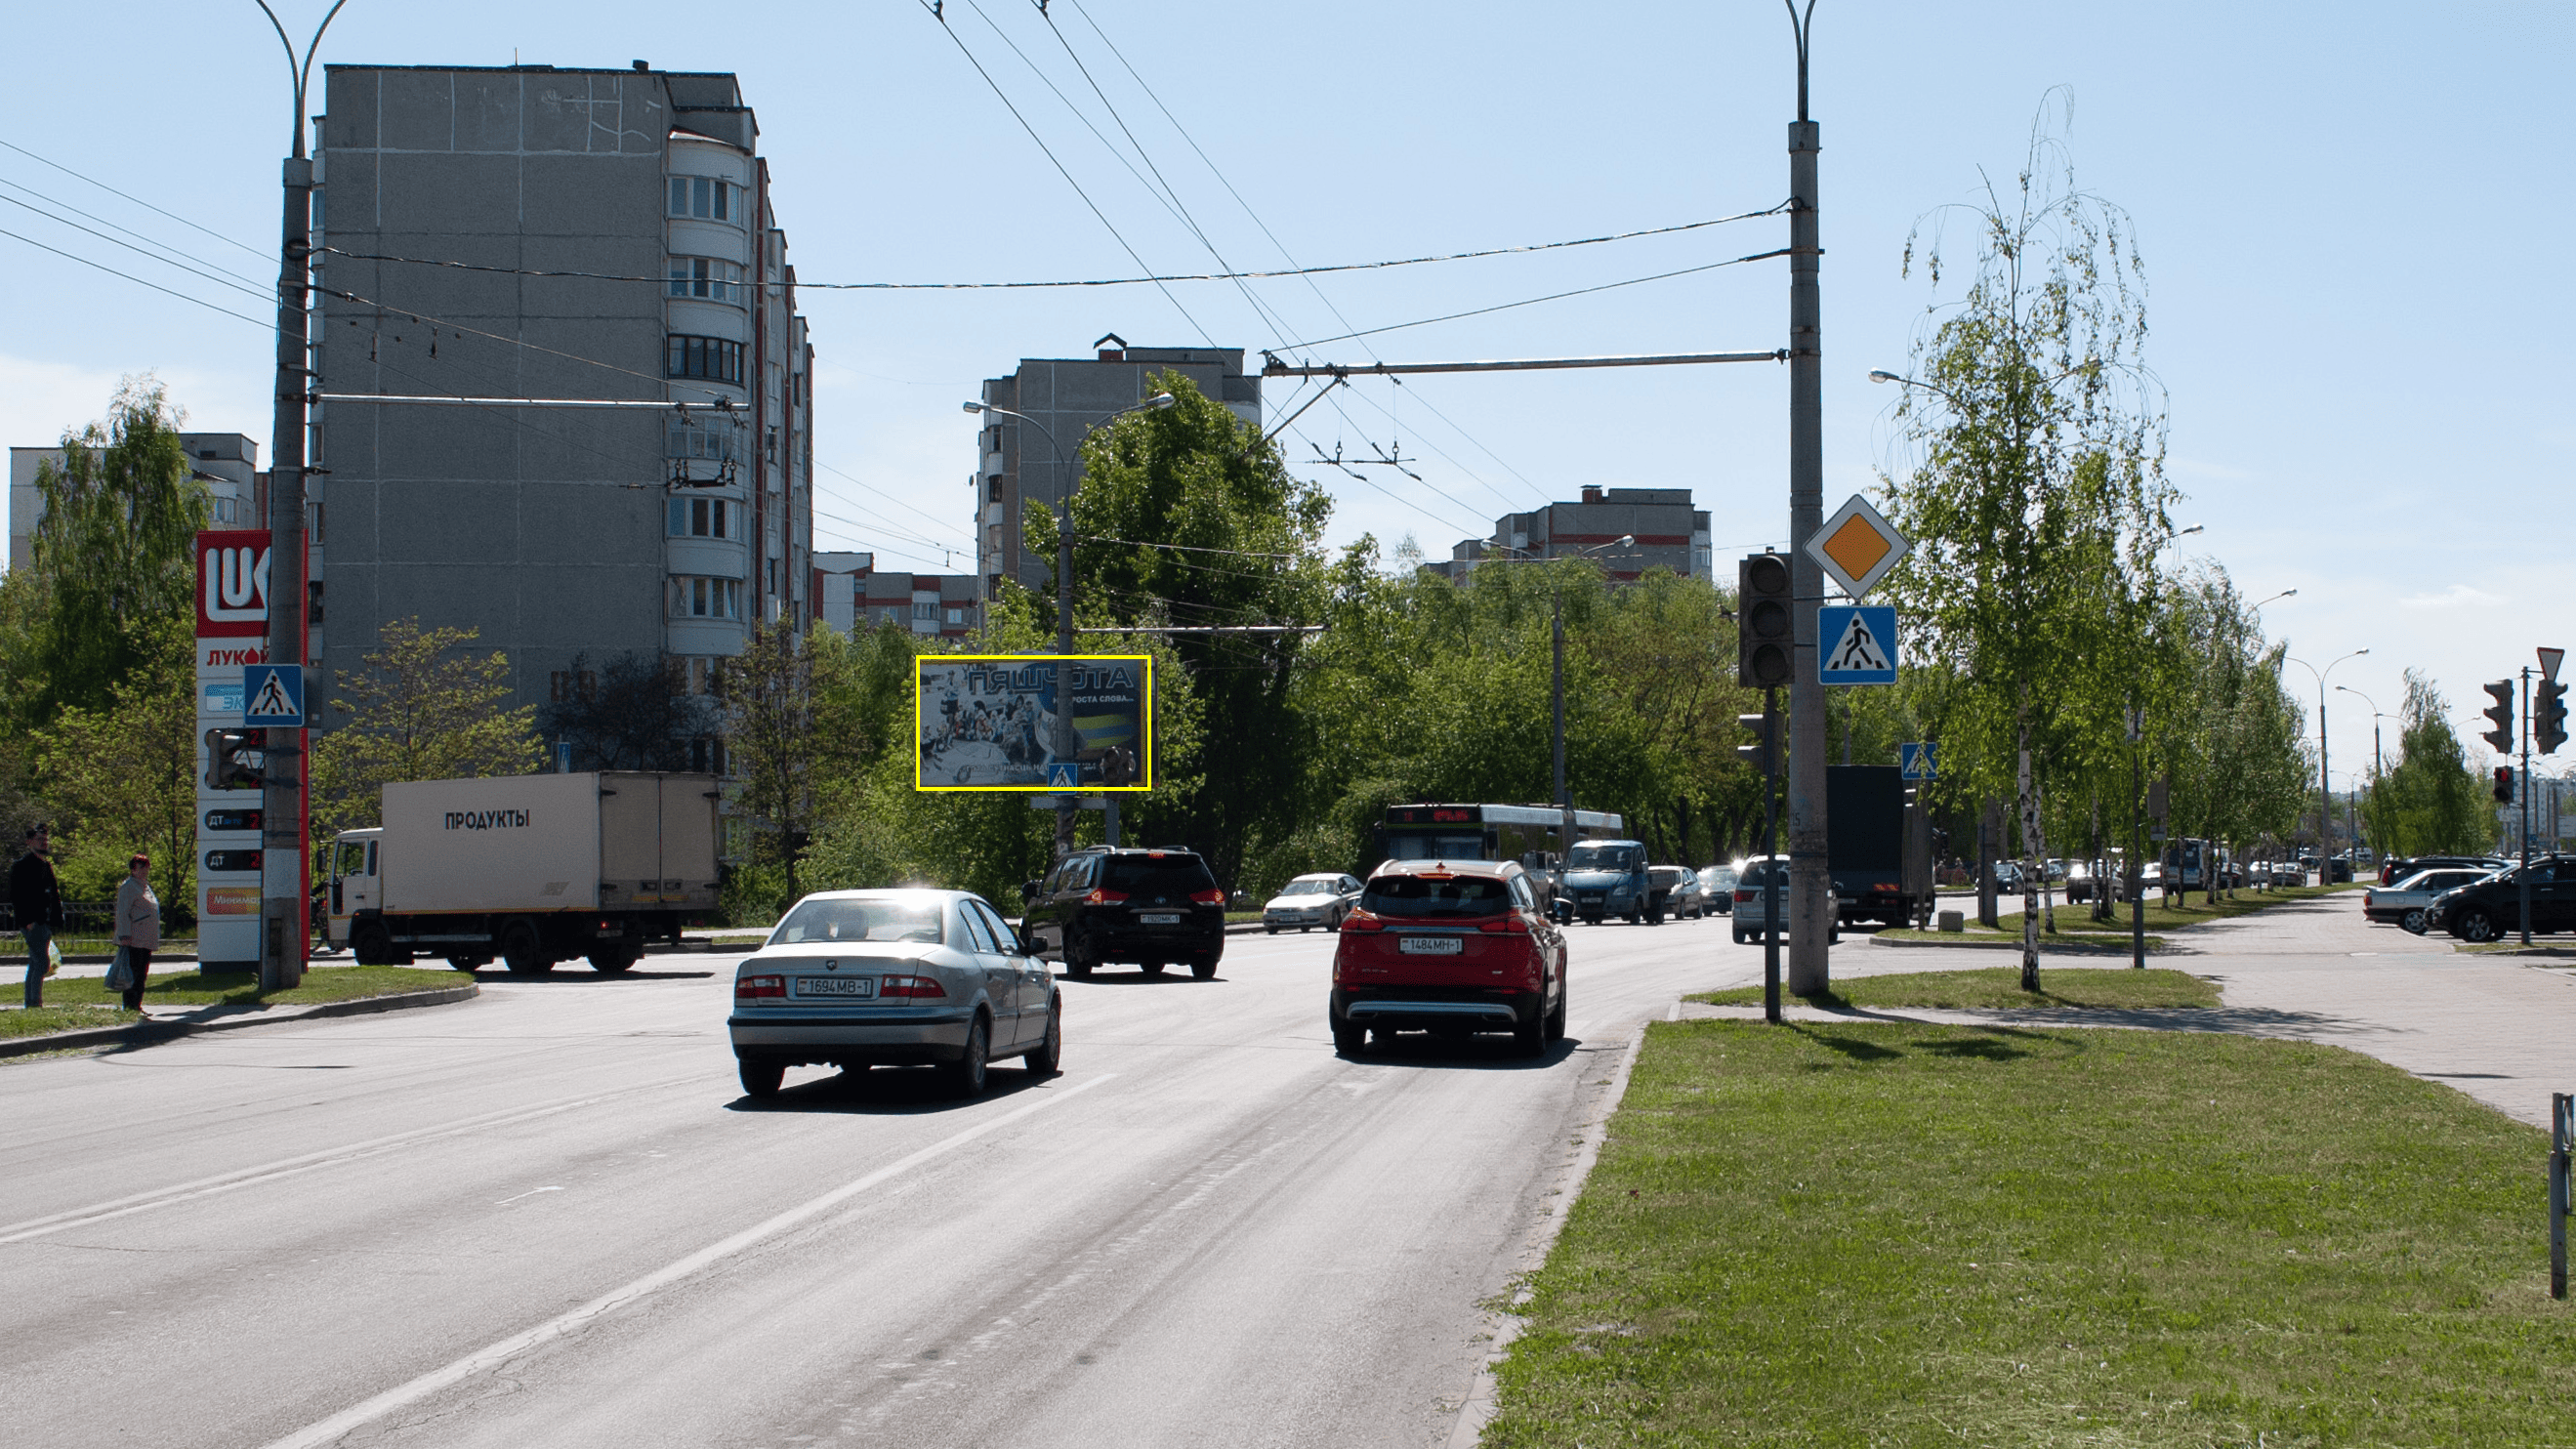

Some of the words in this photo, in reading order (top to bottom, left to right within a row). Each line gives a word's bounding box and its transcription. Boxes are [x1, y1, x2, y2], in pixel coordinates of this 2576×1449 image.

[209, 815, 224, 826] ДТ
[445, 809, 530, 830] ПРОДУКТЫ
[210, 856, 225, 867] ДТ
